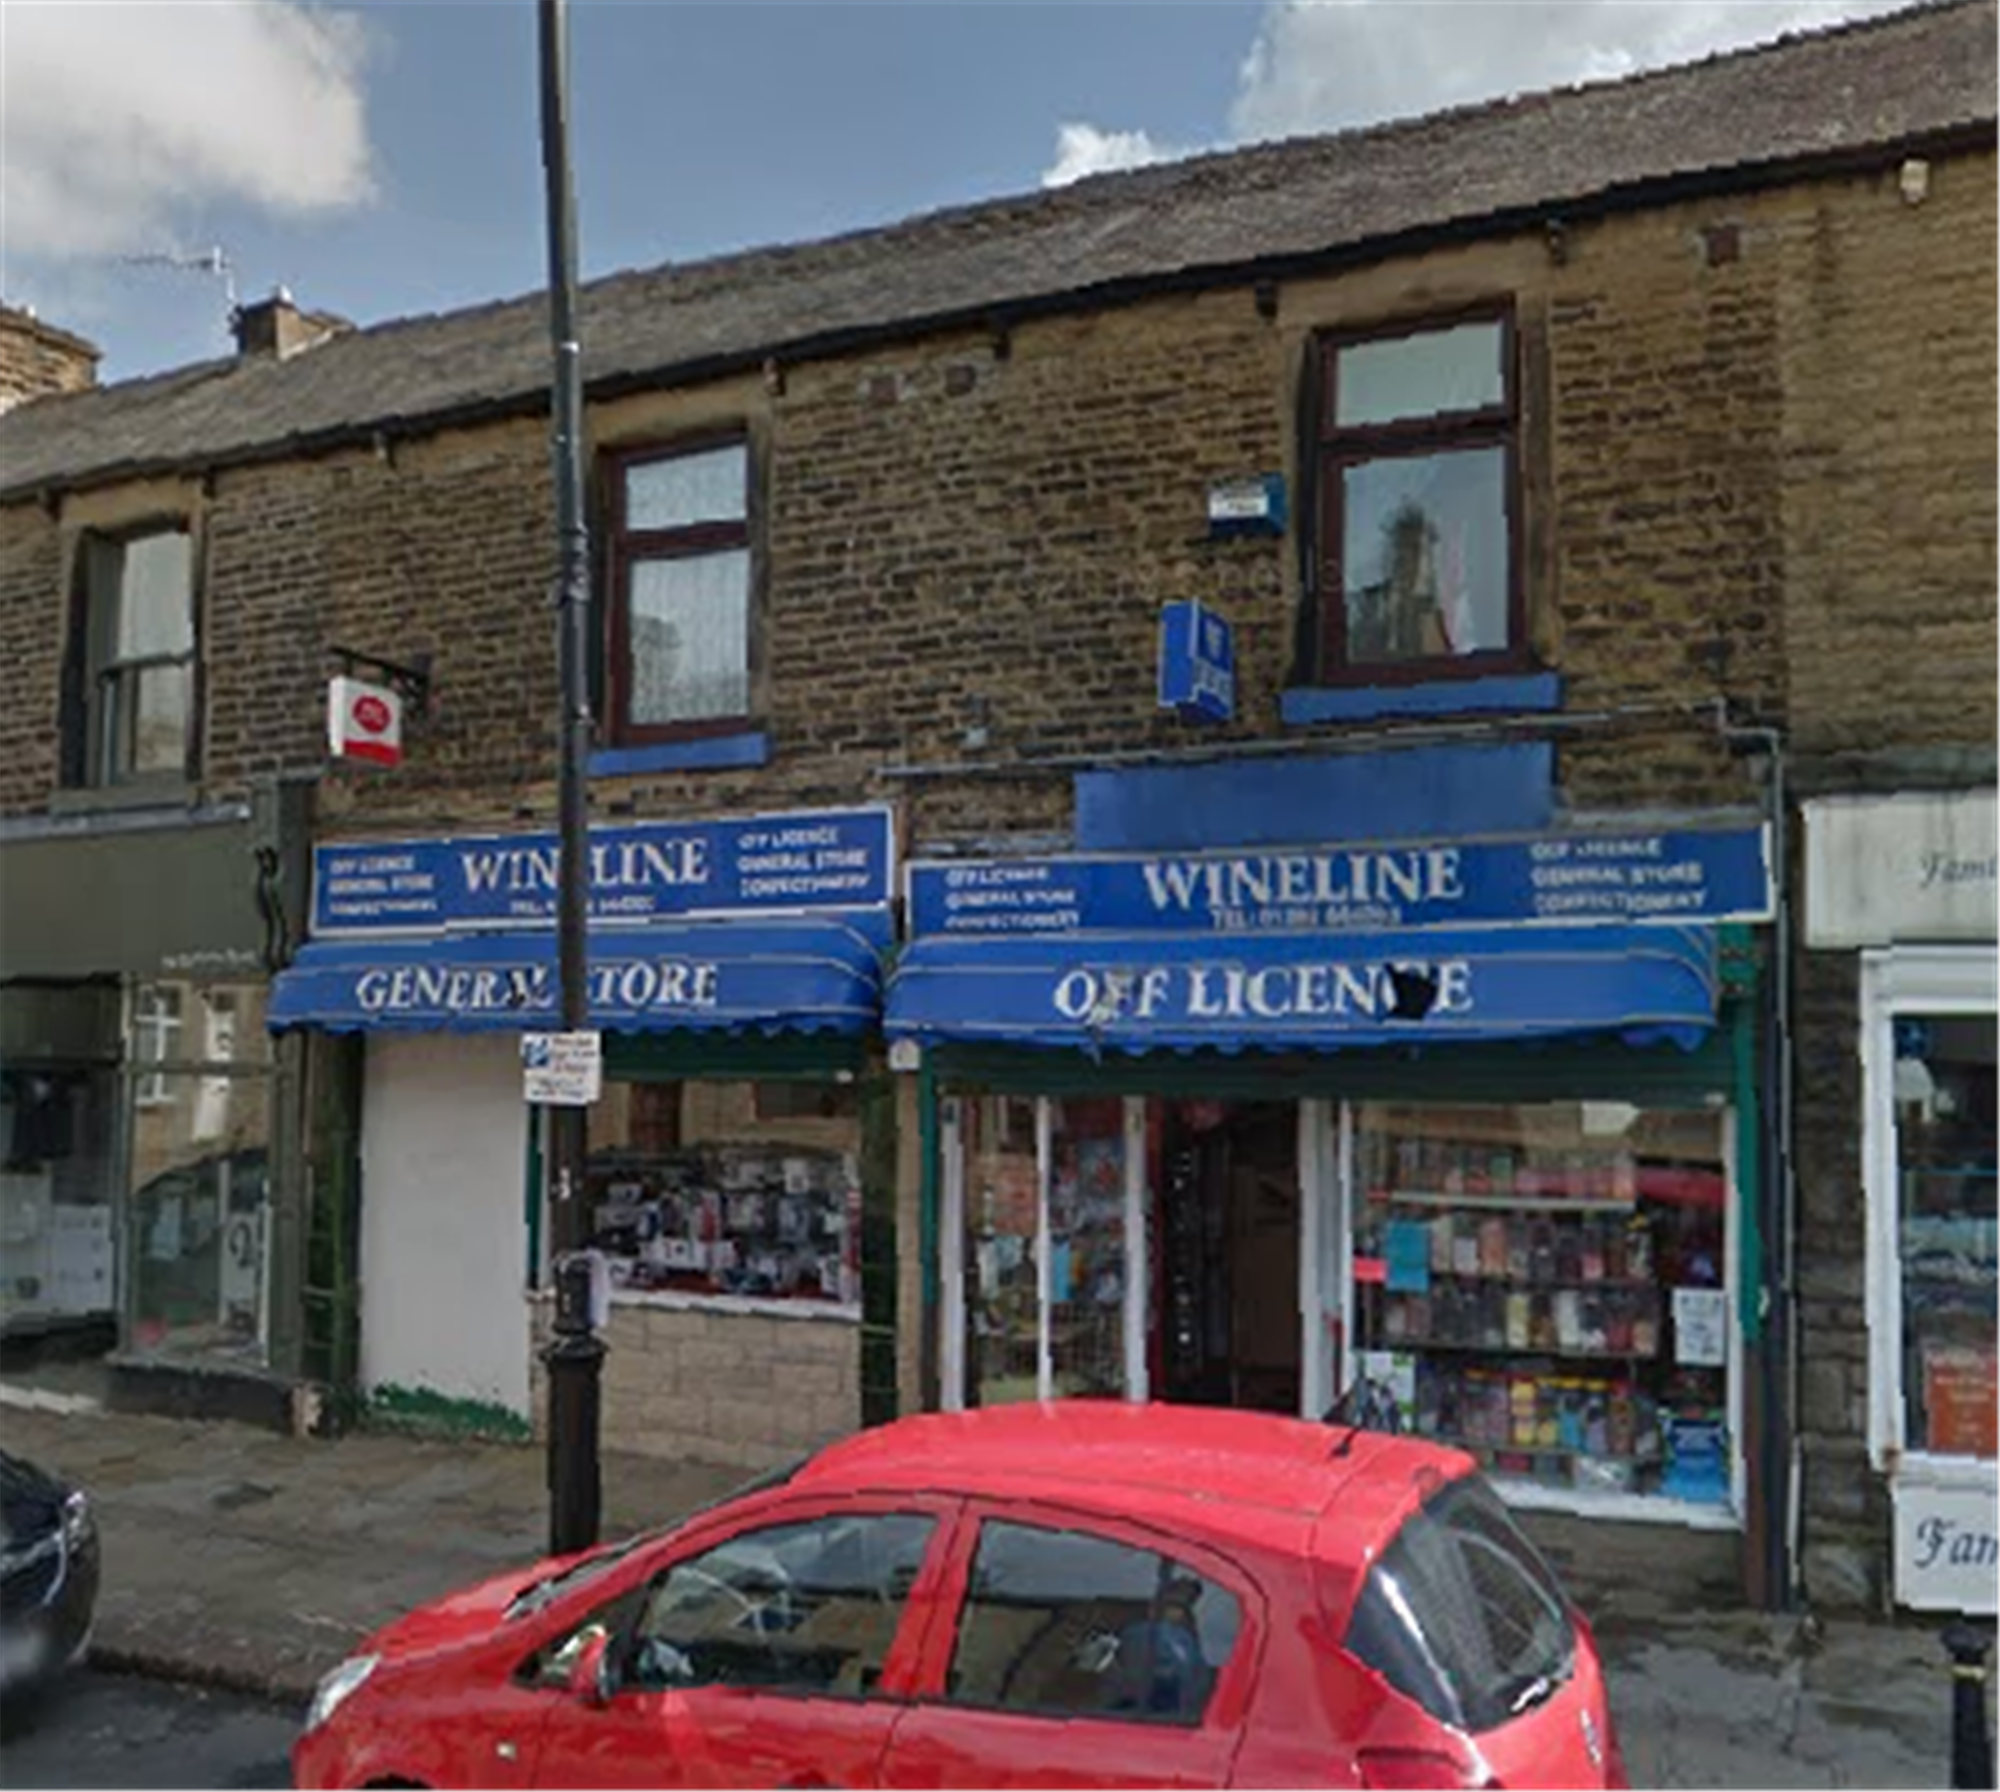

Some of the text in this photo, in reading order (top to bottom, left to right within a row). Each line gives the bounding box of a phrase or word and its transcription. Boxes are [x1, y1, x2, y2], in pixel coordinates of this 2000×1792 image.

[461, 838, 708, 893] WINLINE
[1143, 848, 1463, 909] WINELINE
[355, 960, 718, 1010] GENERAL TORE
[1053, 960, 1474, 1019] OFF LICENE
